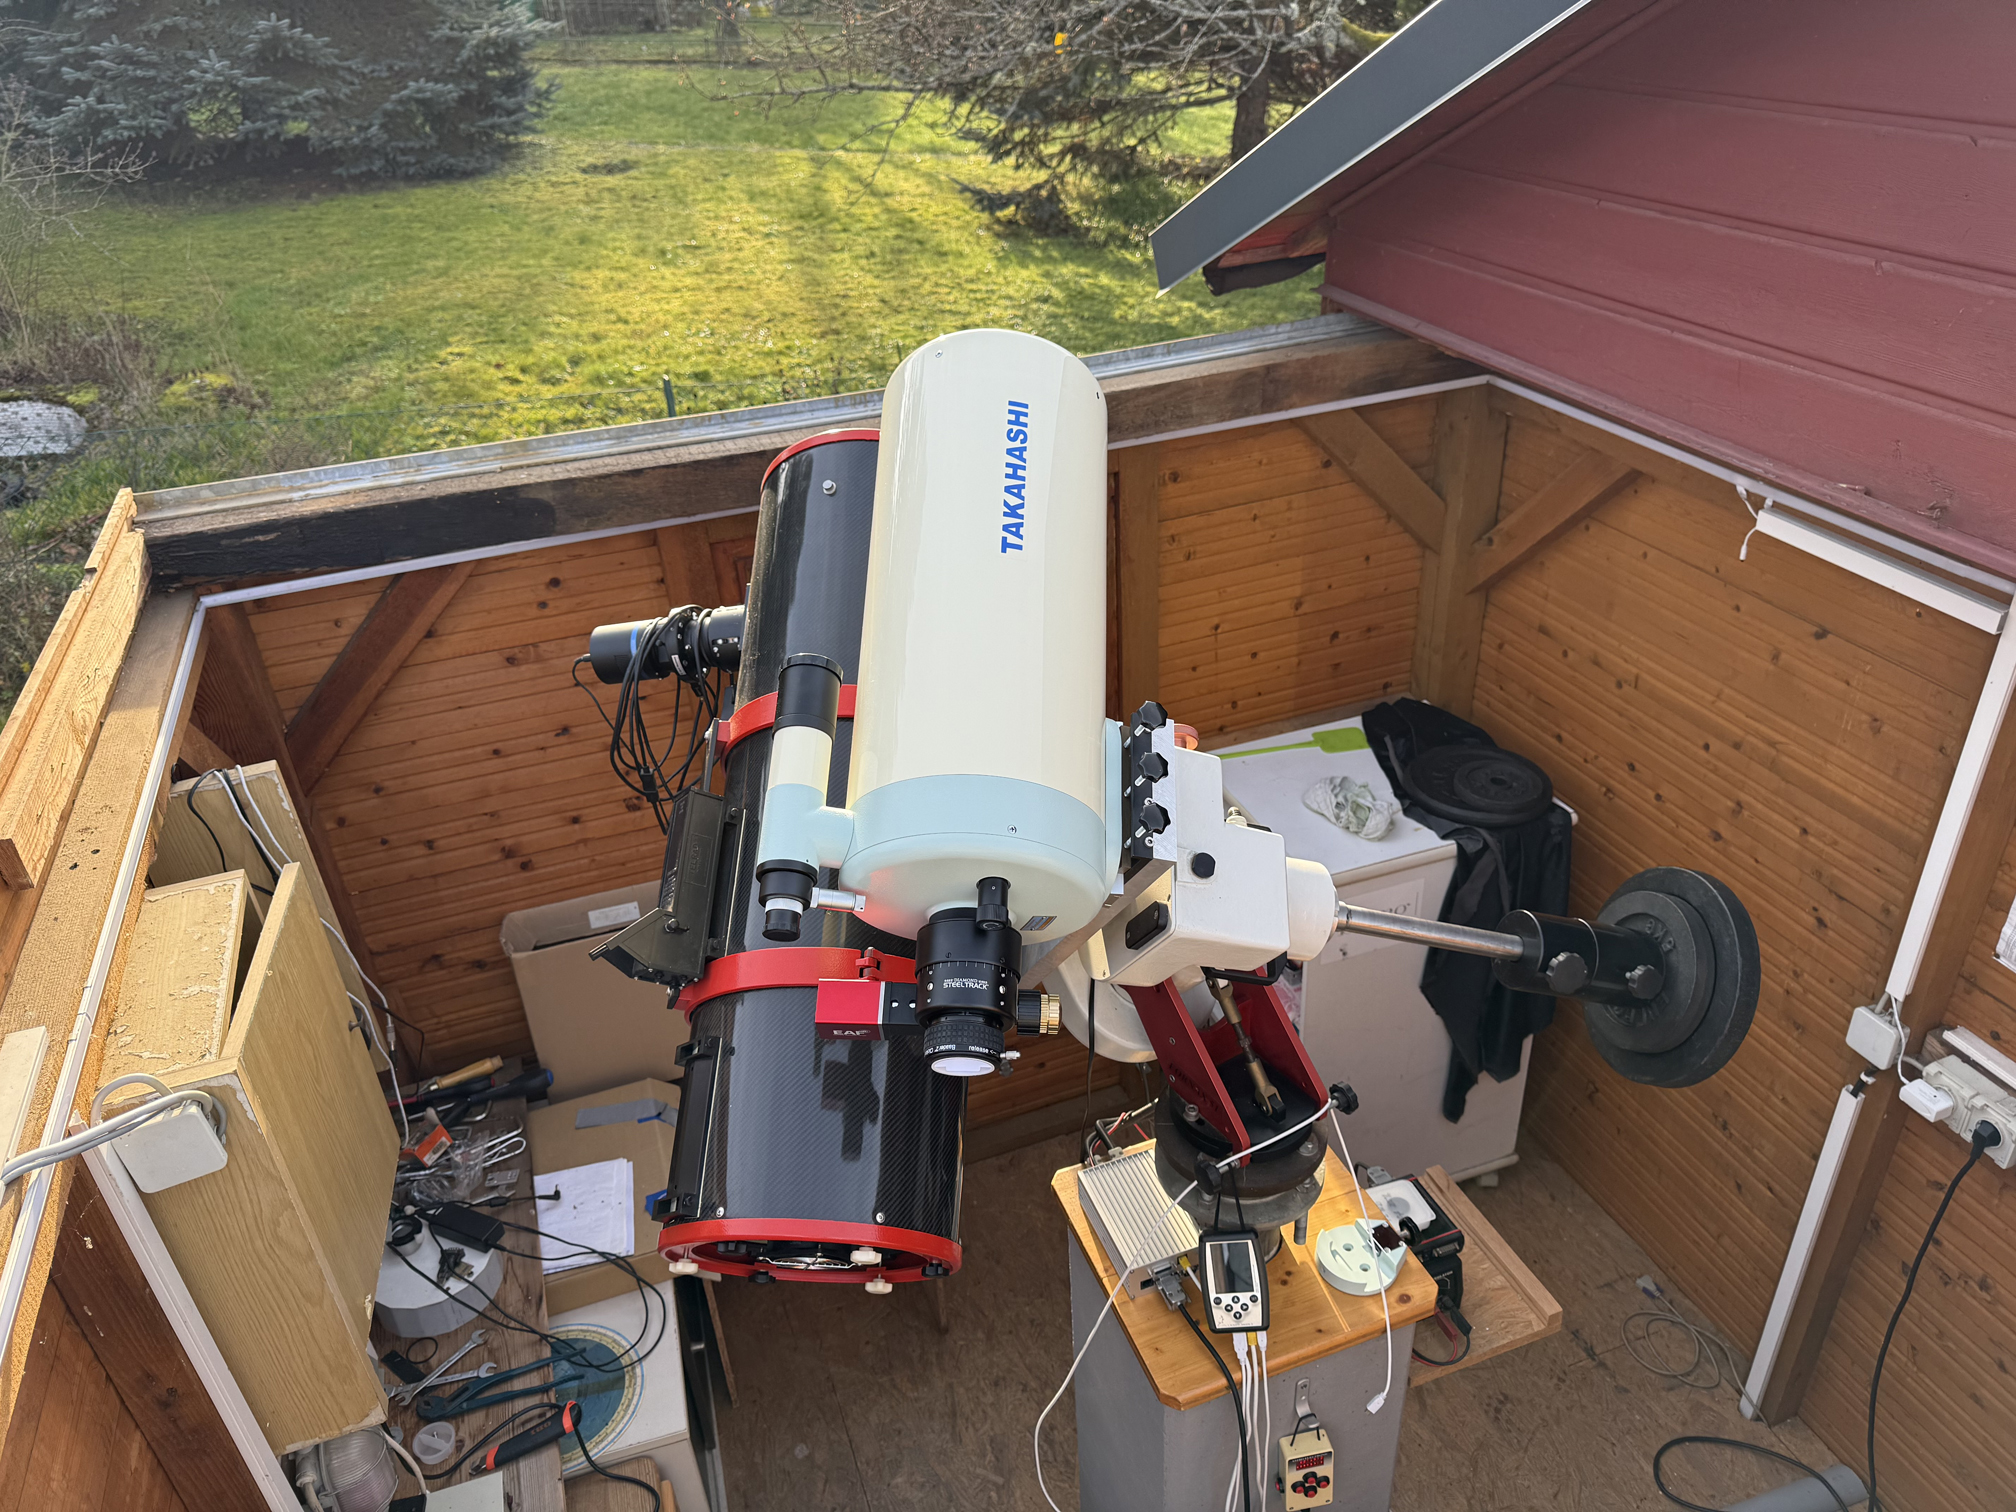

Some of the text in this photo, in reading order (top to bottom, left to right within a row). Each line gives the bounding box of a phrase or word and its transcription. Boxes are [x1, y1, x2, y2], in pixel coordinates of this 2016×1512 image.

[1000, 400, 1030, 554] TAKAHASHI
[943, 981, 989, 991] STEELTRACK
[832, 1029, 867, 1037] EAF
[968, 1045, 989, 1054] release
